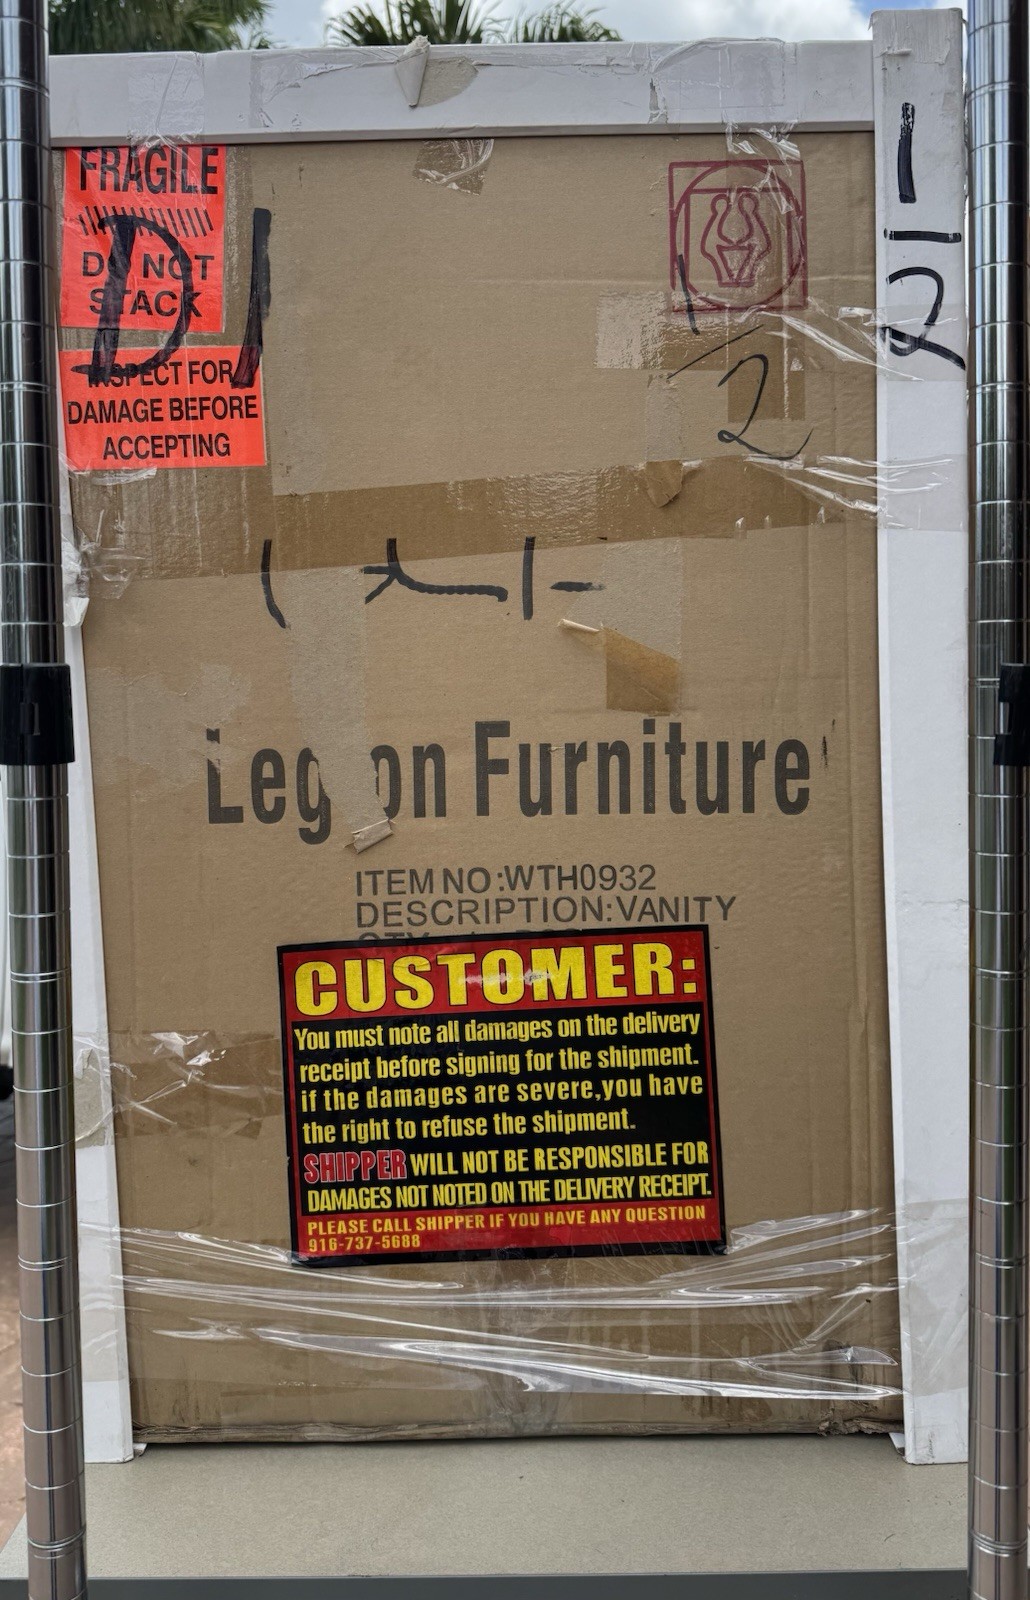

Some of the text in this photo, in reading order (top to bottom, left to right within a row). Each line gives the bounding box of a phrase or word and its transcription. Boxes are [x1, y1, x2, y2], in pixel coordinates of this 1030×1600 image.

[79, 147, 218, 195] FRAGILE
[143, 253, 215, 281] NOT
[88, 360, 233, 388] SPECT FOR
[68, 395, 258, 425] DAMAGE BEFORE
[103, 433, 231, 460] ACCEPTING
[475, 718, 811, 818] Furniture
[356, 868, 434, 897] ITEM
[294, 942, 697, 1016] CUSTOMER:
[294, 1011, 700, 1051] You must note all damages on the delivery
[300, 1043, 699, 1083] receipt before signing for the shipment.
[301, 1089, 317, 1113] if
[323, 1088, 359, 1111] the
[366, 1085, 467, 1109] damages
[474, 1083, 510, 1104] are
[649, 1073, 703, 1097] have
[303, 1107, 636, 1145] the right to refuse the shipment.
[303, 1141, 709, 1185] SHIPPER WILL NOT BE RESPONSIBLE FOR
[307, 1172, 712, 1213] DAMAGES NOT NOTED ON THE DELIVERY RECEIPT.
[307, 1205, 706, 1236] PLEASE CALL SHIPPER IF YOU HAVE ANY QUESTION
[308, 1234, 421, 1253] 916-737-5688
